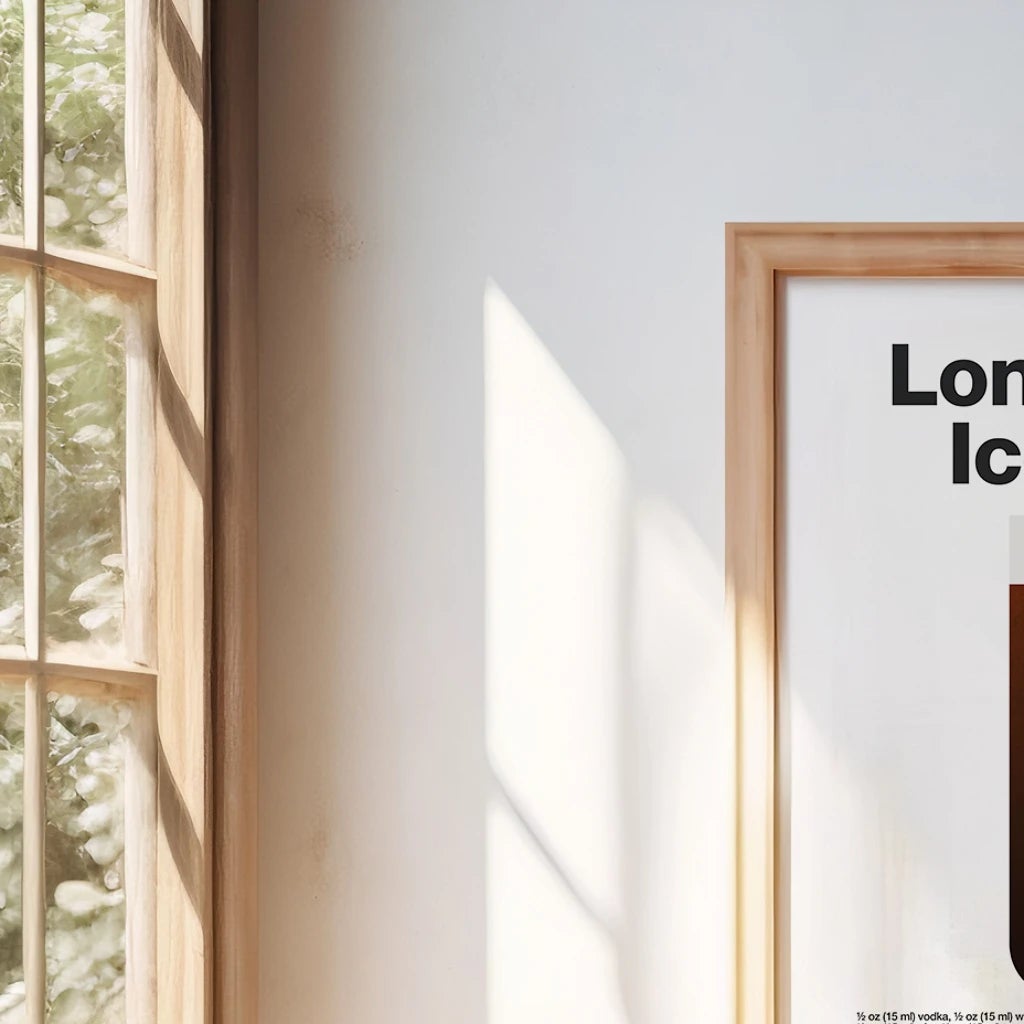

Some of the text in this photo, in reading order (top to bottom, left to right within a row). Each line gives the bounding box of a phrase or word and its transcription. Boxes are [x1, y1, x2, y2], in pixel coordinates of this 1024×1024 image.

[867, 1013, 881, 1022] oz
[882, 1011, 899, 1024] (15
[899, 1011, 916, 1024] ml)
[917, 1011, 952, 1024] vodka,
[964, 1013, 979, 1022] oz
[979, 1011, 997, 1024] (15
[997, 1011, 1014, 1024] ml)
